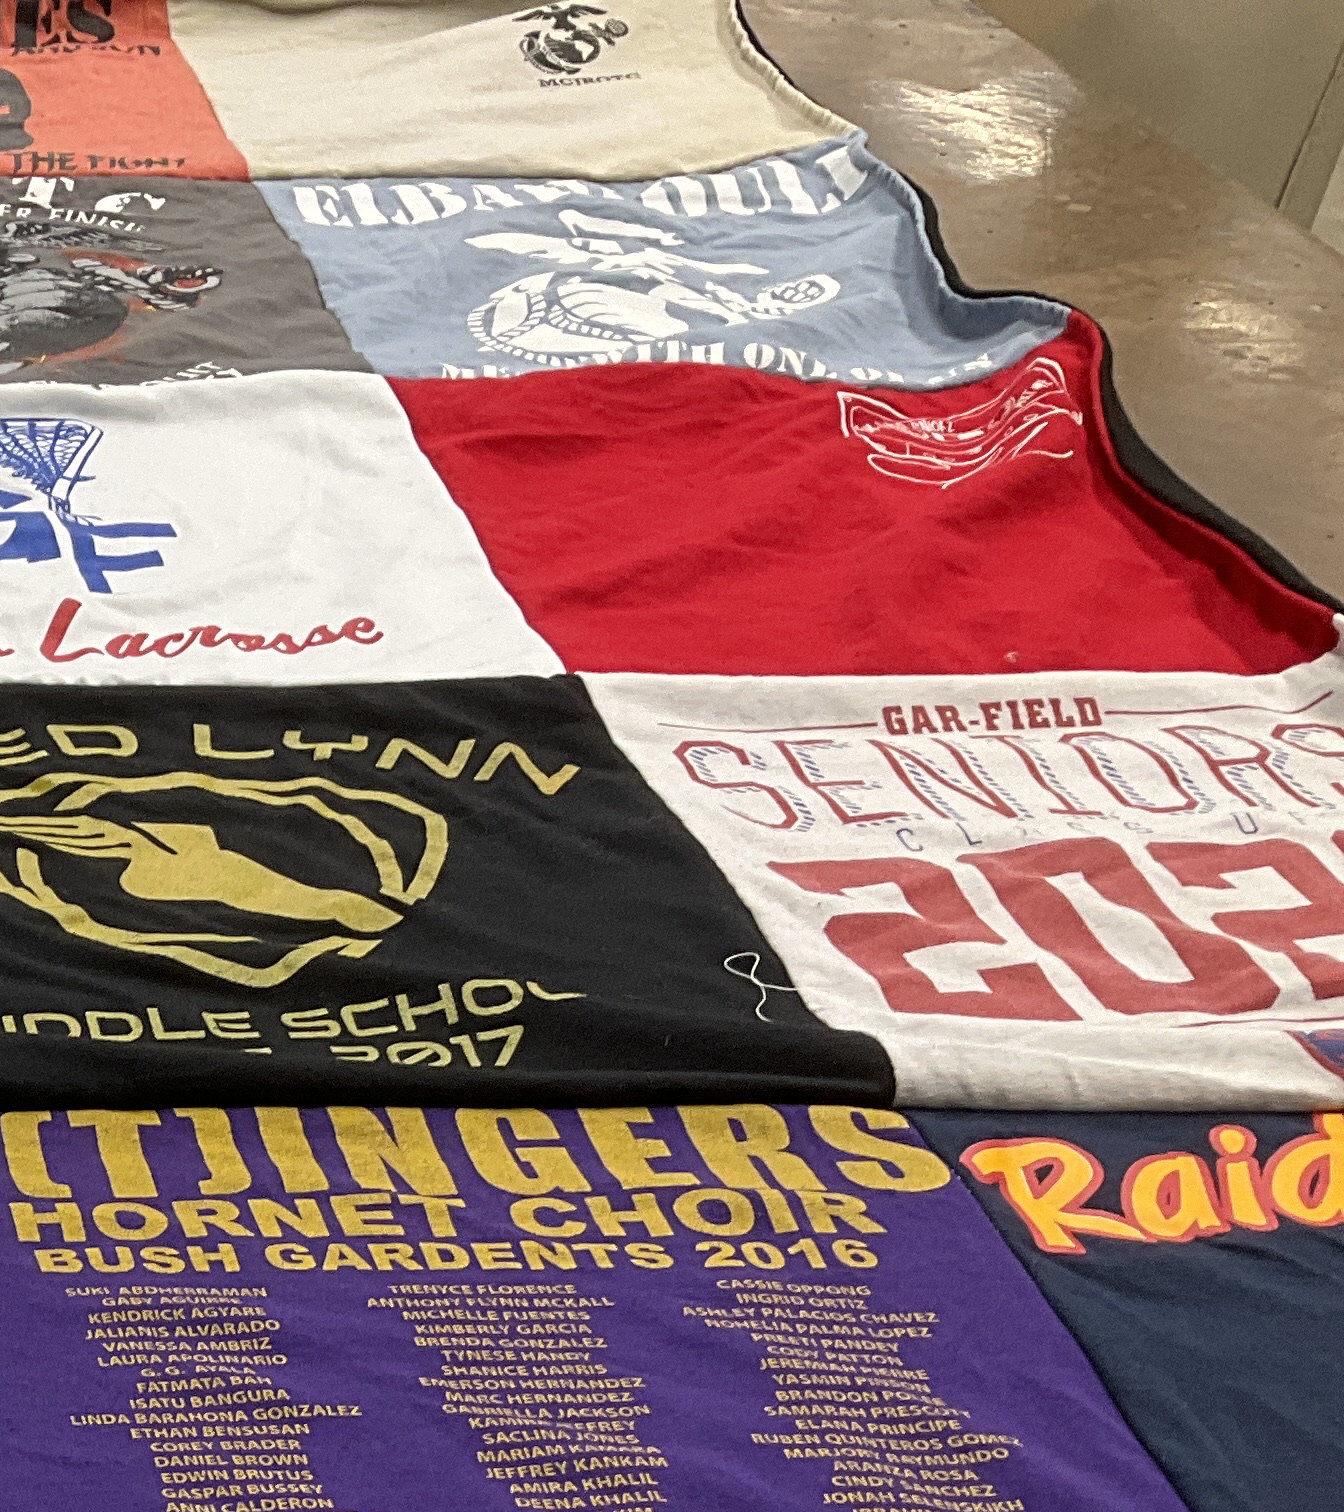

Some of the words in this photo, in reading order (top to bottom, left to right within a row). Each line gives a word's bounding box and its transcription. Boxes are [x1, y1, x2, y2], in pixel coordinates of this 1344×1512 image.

[12, 150, 79, 173] THE
[291, 145, 868, 228] ELBAOULI
[38, 597, 385, 663] Lacrosse
[881, 697, 1102, 736] GAR-FIELD
[193, 722, 582, 797] LYNN
[766, 835, 1344, 1022] 202
[279, 979, 587, 1040] SCHO
[8, 1192, 470, 1244] HORNET
[507, 1188, 887, 1240] CHOIR
[34, 1239, 241, 1274] BUSH
[263, 1237, 676, 1272] GARDENTS
[696, 1236, 880, 1271] 2016
[88, 1308, 185, 1324] KENDRICK
[86, 1326, 169, 1340] JALIANIS
[174, 1320, 280, 1337] ALVARADO
[102, 1342, 192, 1352] VANESSA
[197, 1336, 272, 1350] AMBRIZ
[442, 1350, 517, 1361] TYNESE
[521, 1351, 590, 1361] HANDY
[441, 1365, 529, 1376] SHANICE
[532, 1364, 607, 1376] HARRIS
[129, 1398, 185, 1409] ISATU
[190, 1389, 290, 1408] BANGURA
[70, 1414, 130, 1426] LINDA
[134, 1410, 248, 1424] BARAHONA
[252, 1404, 362, 1420] GONZALEZ
[130, 1426, 197, 1439] ETHAN
[203, 1424, 310, 1436] BENSUSAN
[795, 1419, 865, 1432] ELANA
[866, 1419, 963, 1435] PRINCIPE
[154, 1455, 228, 1467] DANIEL
[232, 1454, 308, 1466] BROWN
[161, 1485, 242, 1499] GASPAR
[247, 1484, 322, 1495] BUSSEY
[510, 1481, 578, 1494] AMIRA
[581, 1472, 659, 1491] KHALIL
